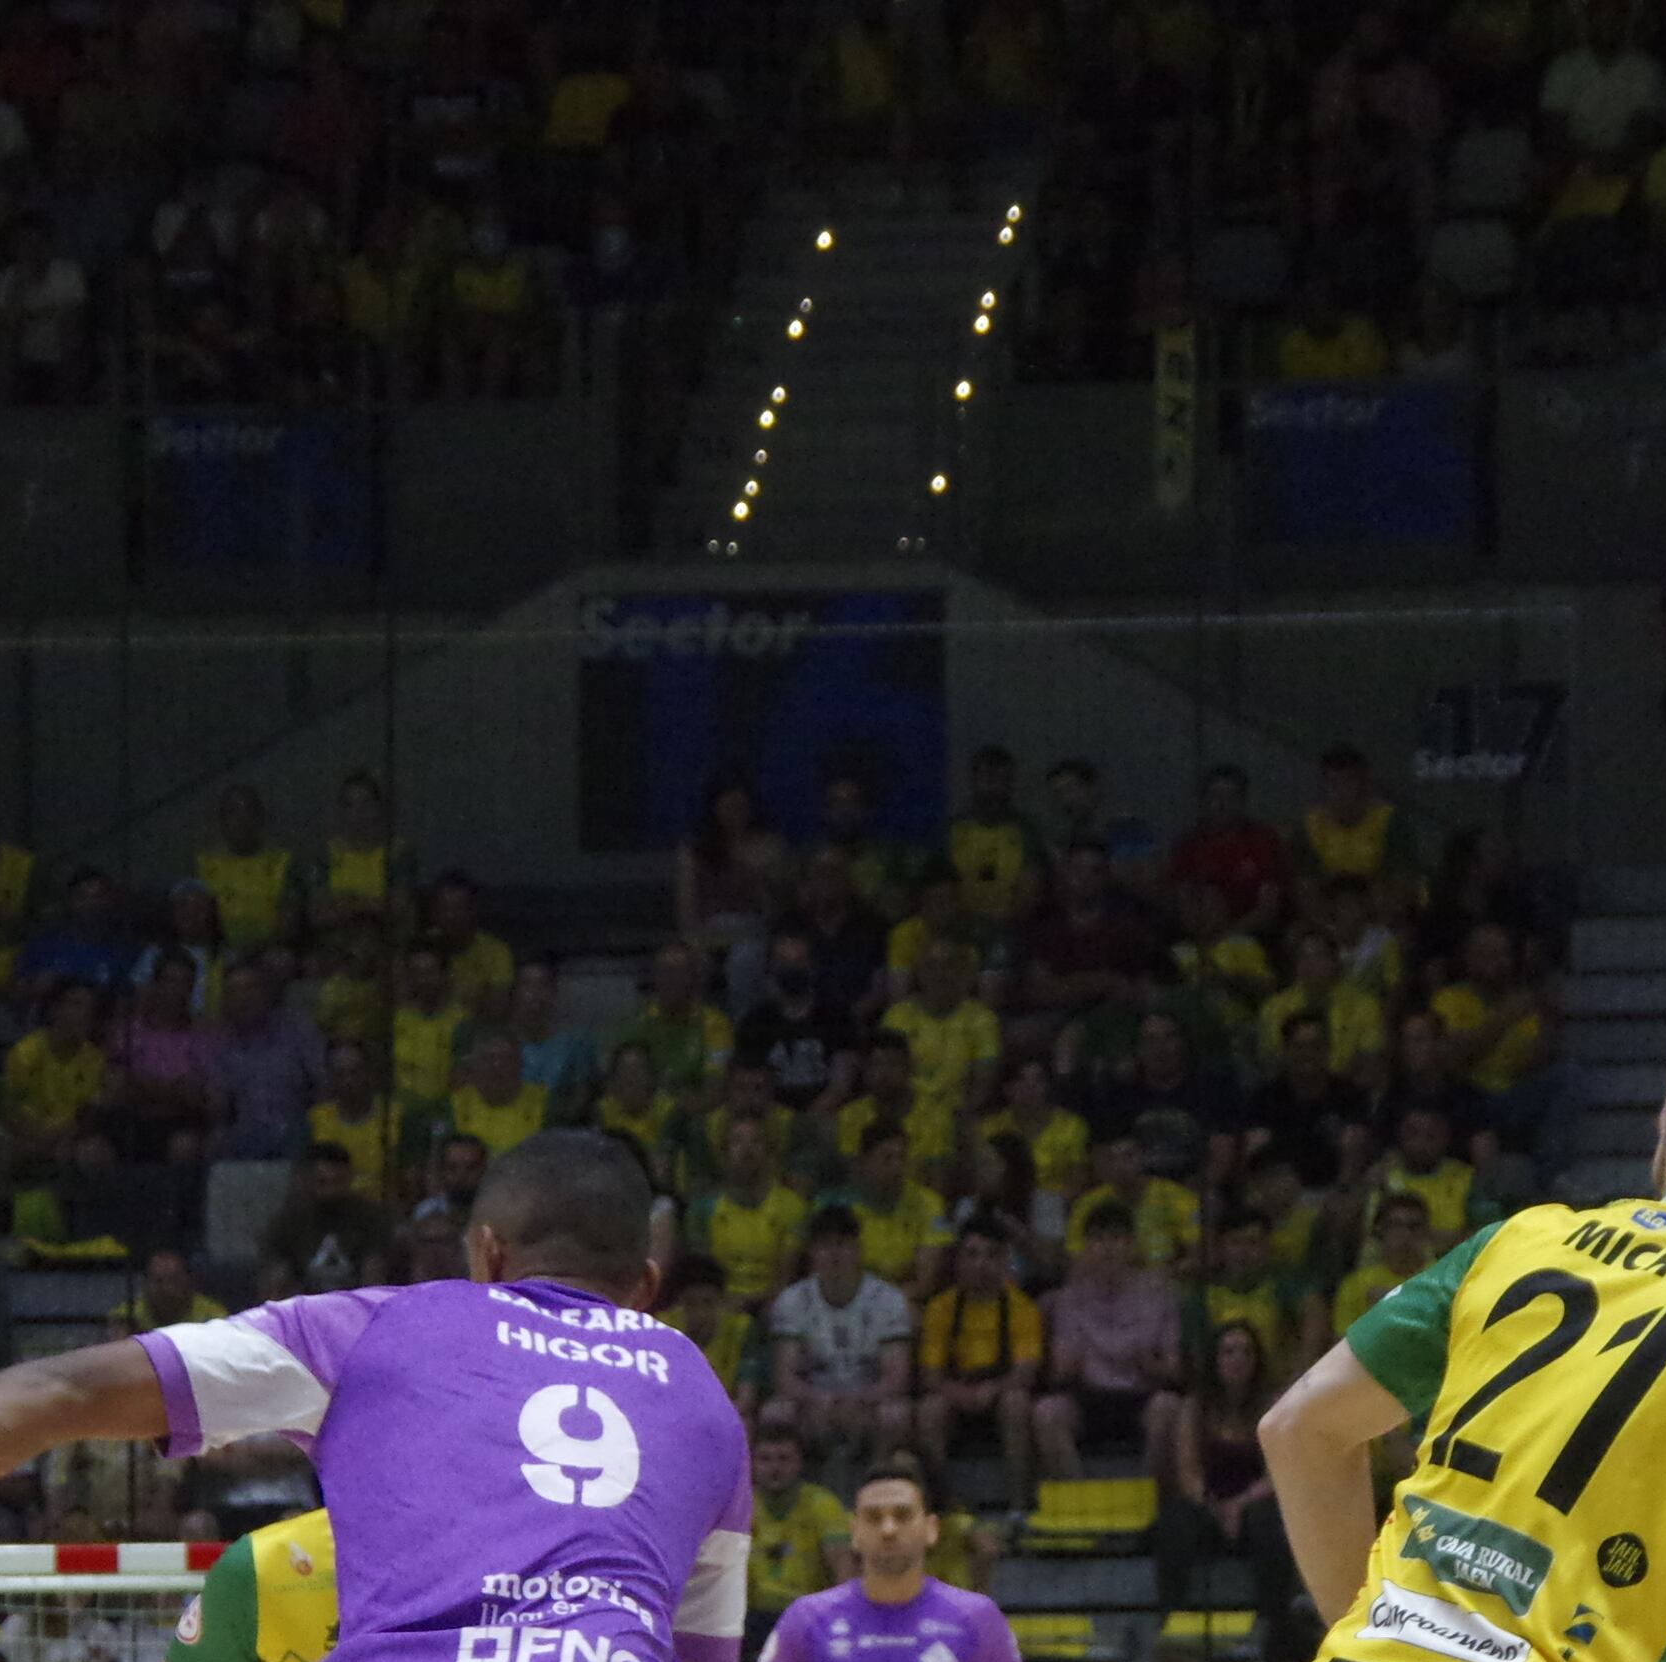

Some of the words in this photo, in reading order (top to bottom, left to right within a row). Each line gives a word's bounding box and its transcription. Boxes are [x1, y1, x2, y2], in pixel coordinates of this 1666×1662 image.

[580, 598, 811, 660] Sector
[496, 1320, 669, 1384] HIGOR
[518, 1384, 640, 1507] 9
[1475, 1541, 1535, 1590] RURAL
